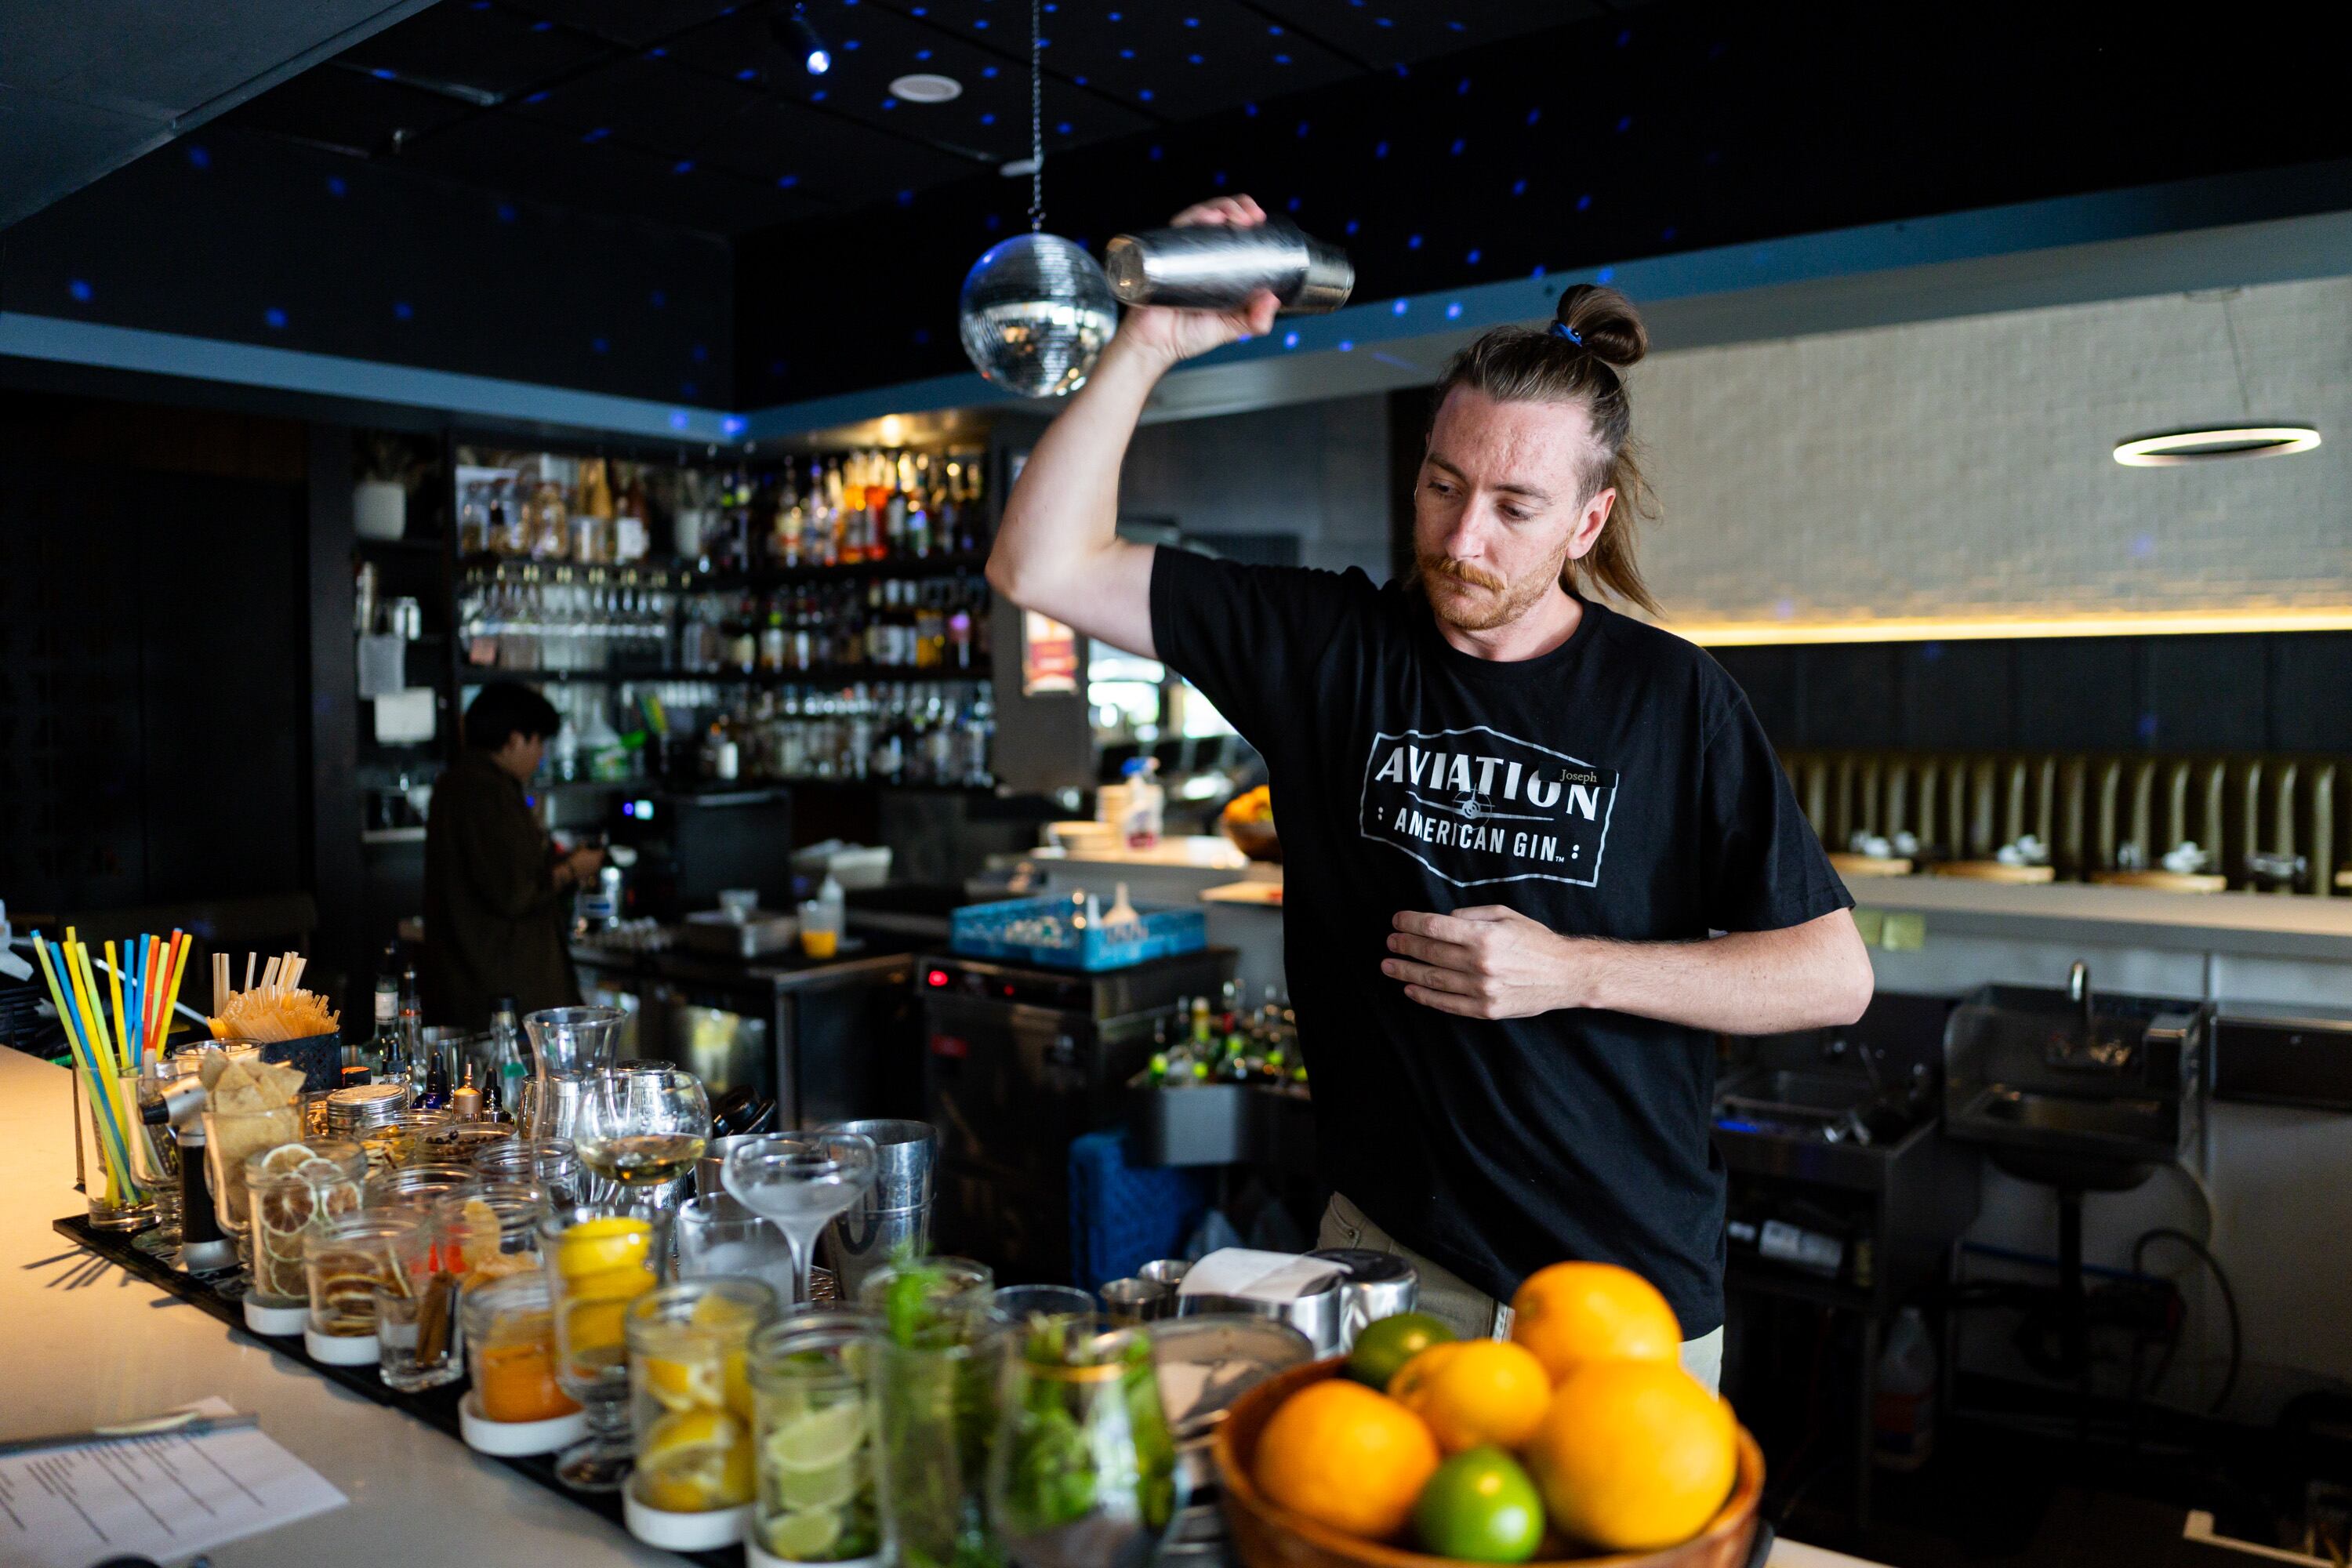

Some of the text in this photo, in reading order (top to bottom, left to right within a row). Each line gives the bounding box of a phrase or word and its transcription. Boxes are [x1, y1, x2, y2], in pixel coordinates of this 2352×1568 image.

[1374, 745, 1600, 821] AVIATION
[1559, 769, 1597, 784] Joseph
[1394, 808, 1505, 853] AMERICAN
